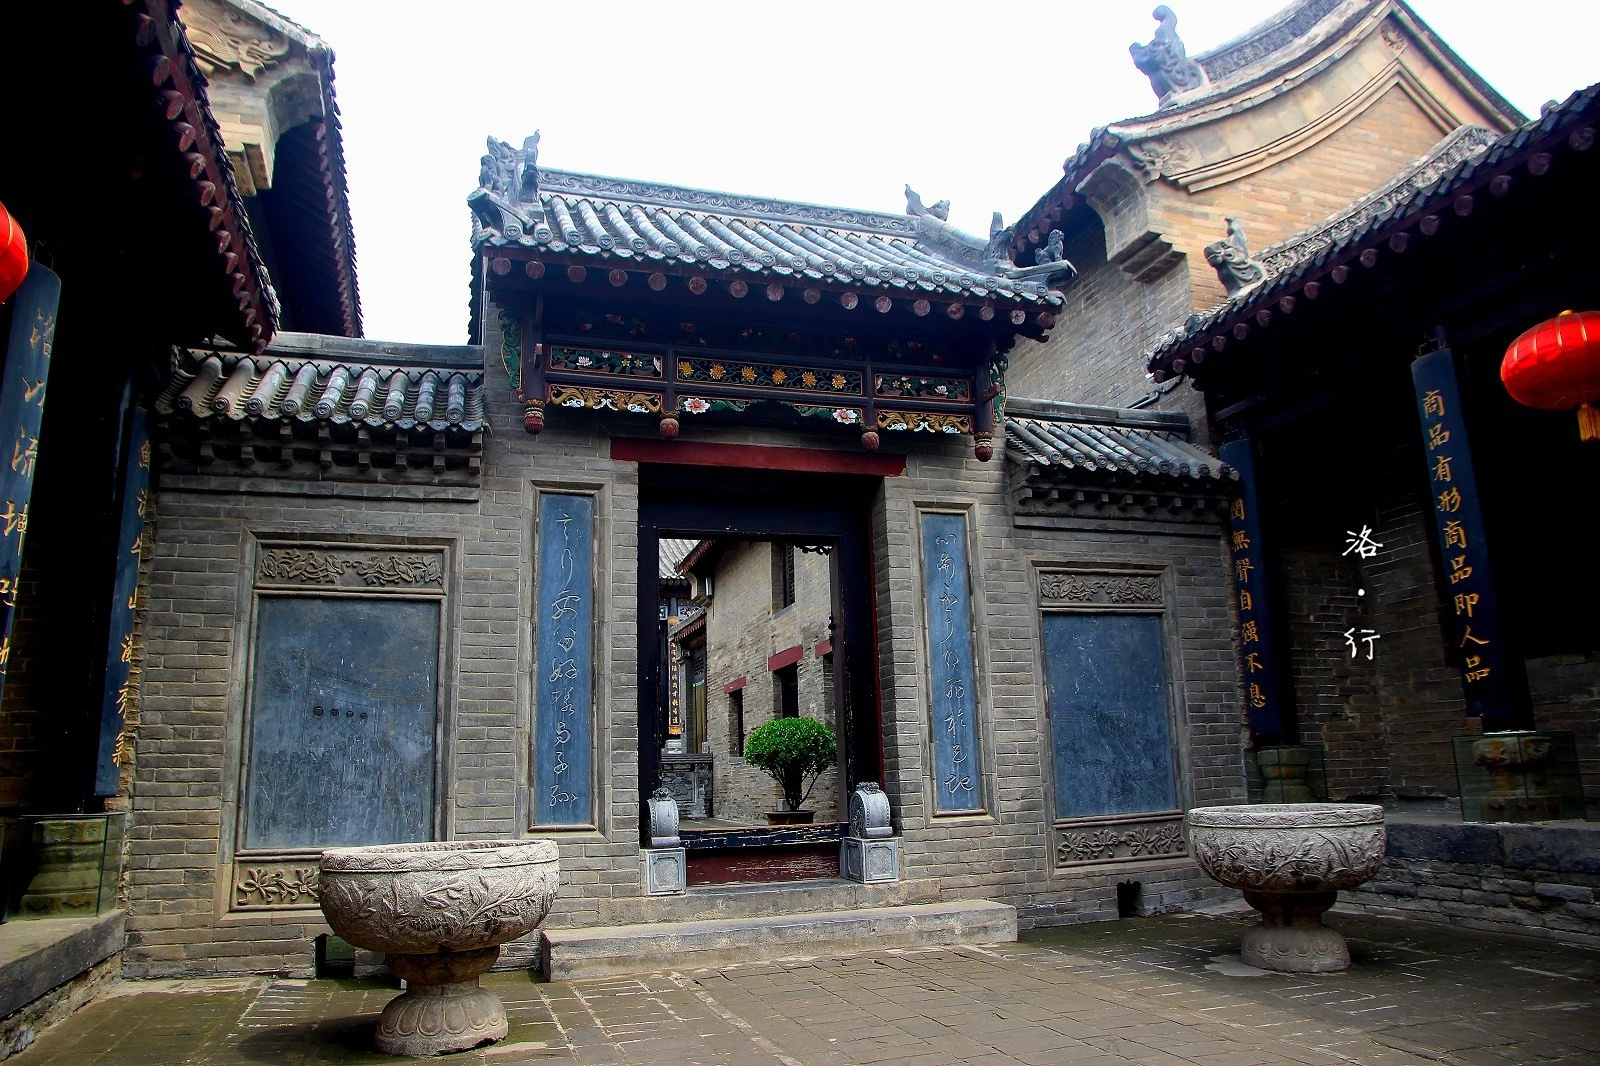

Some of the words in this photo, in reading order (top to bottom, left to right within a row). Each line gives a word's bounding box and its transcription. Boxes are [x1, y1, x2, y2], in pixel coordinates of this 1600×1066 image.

[1421, 388, 1491, 684] 商品有形商品即人品
